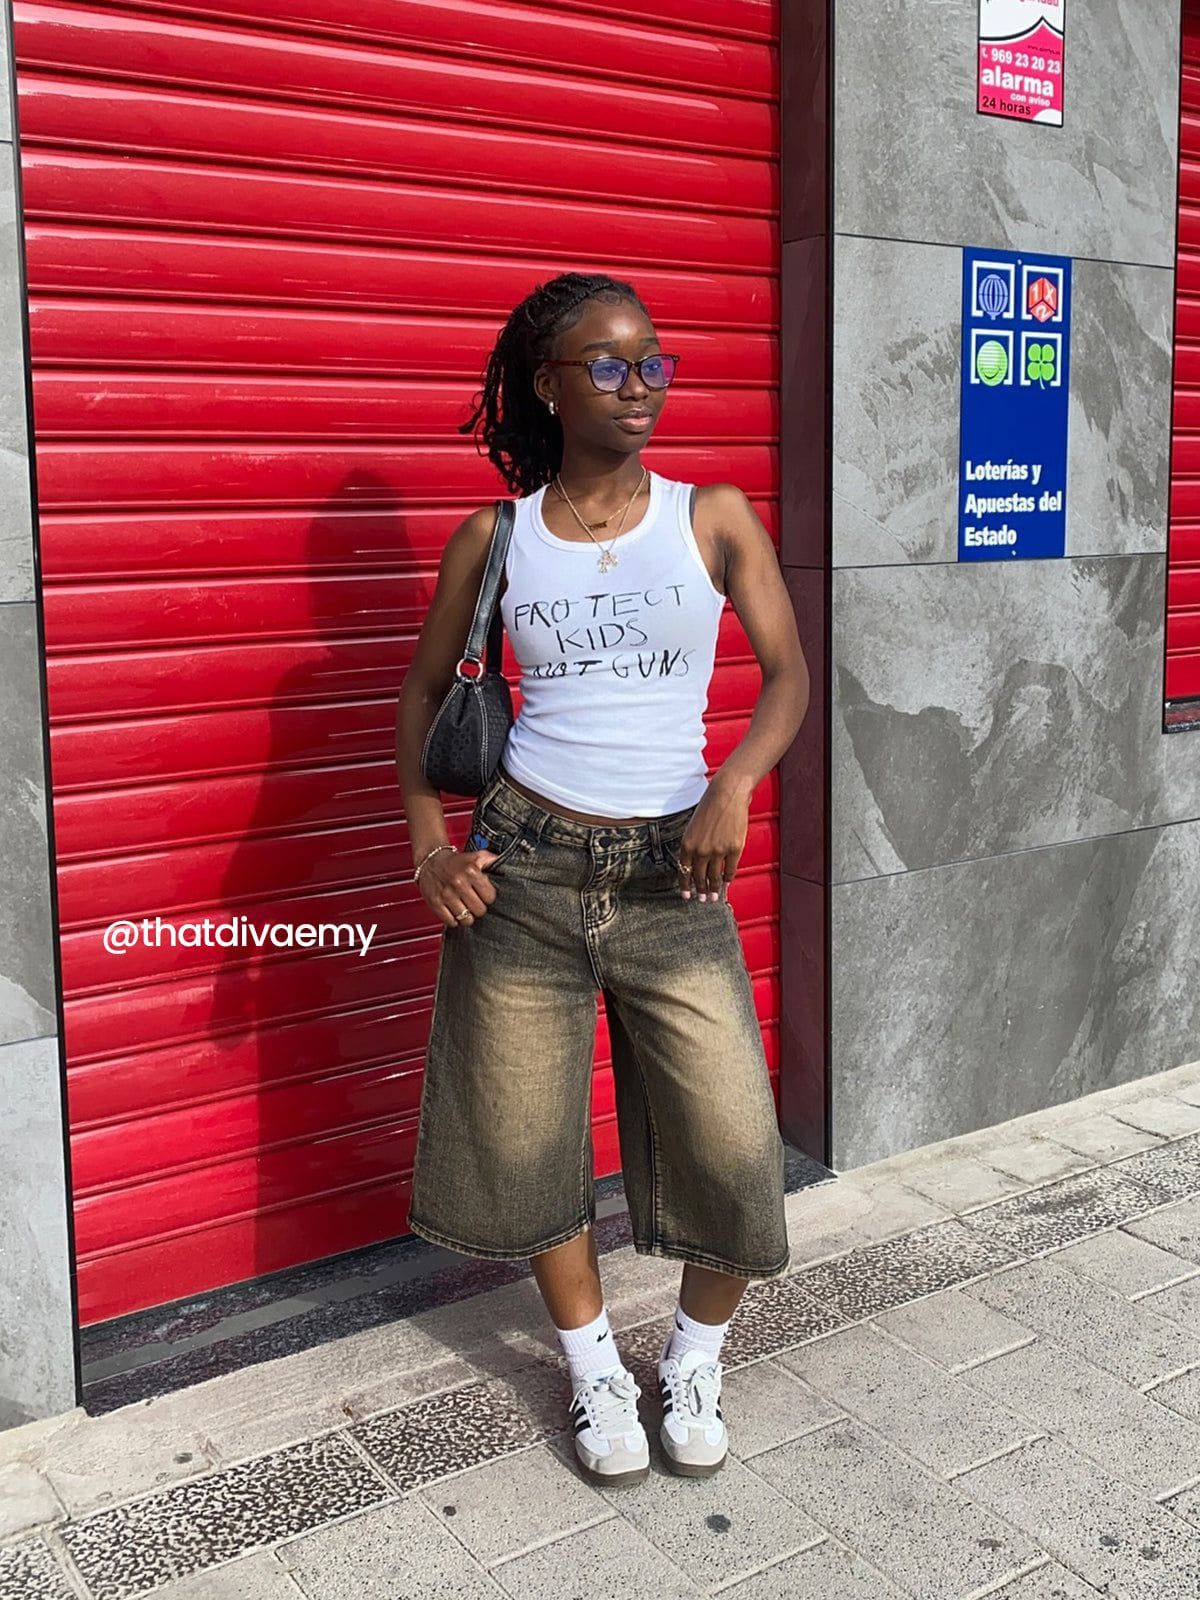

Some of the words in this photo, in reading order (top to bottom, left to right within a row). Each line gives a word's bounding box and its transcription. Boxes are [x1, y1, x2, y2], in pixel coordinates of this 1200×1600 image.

[1015, 52, 1029, 67] 23
[1031, 56, 1045, 71] 20
[1047, 59, 1060, 74] 23
[981, 65, 1054, 97] alarma
[982, 96, 996, 109] 24
[1000, 99, 1031, 115] horas
[1010, 93, 1026, 102] con
[1029, 95, 1050, 107] aviso
[966, 459, 1028, 481] Loterías
[1032, 464, 1042, 485] y
[965, 493, 1035, 518] Apuestas
[1039, 491, 1062, 511] del
[965, 524, 1017, 546] Estado
[556, 617, 649, 653] KIDS
[612, 648, 696, 679] GUNS
